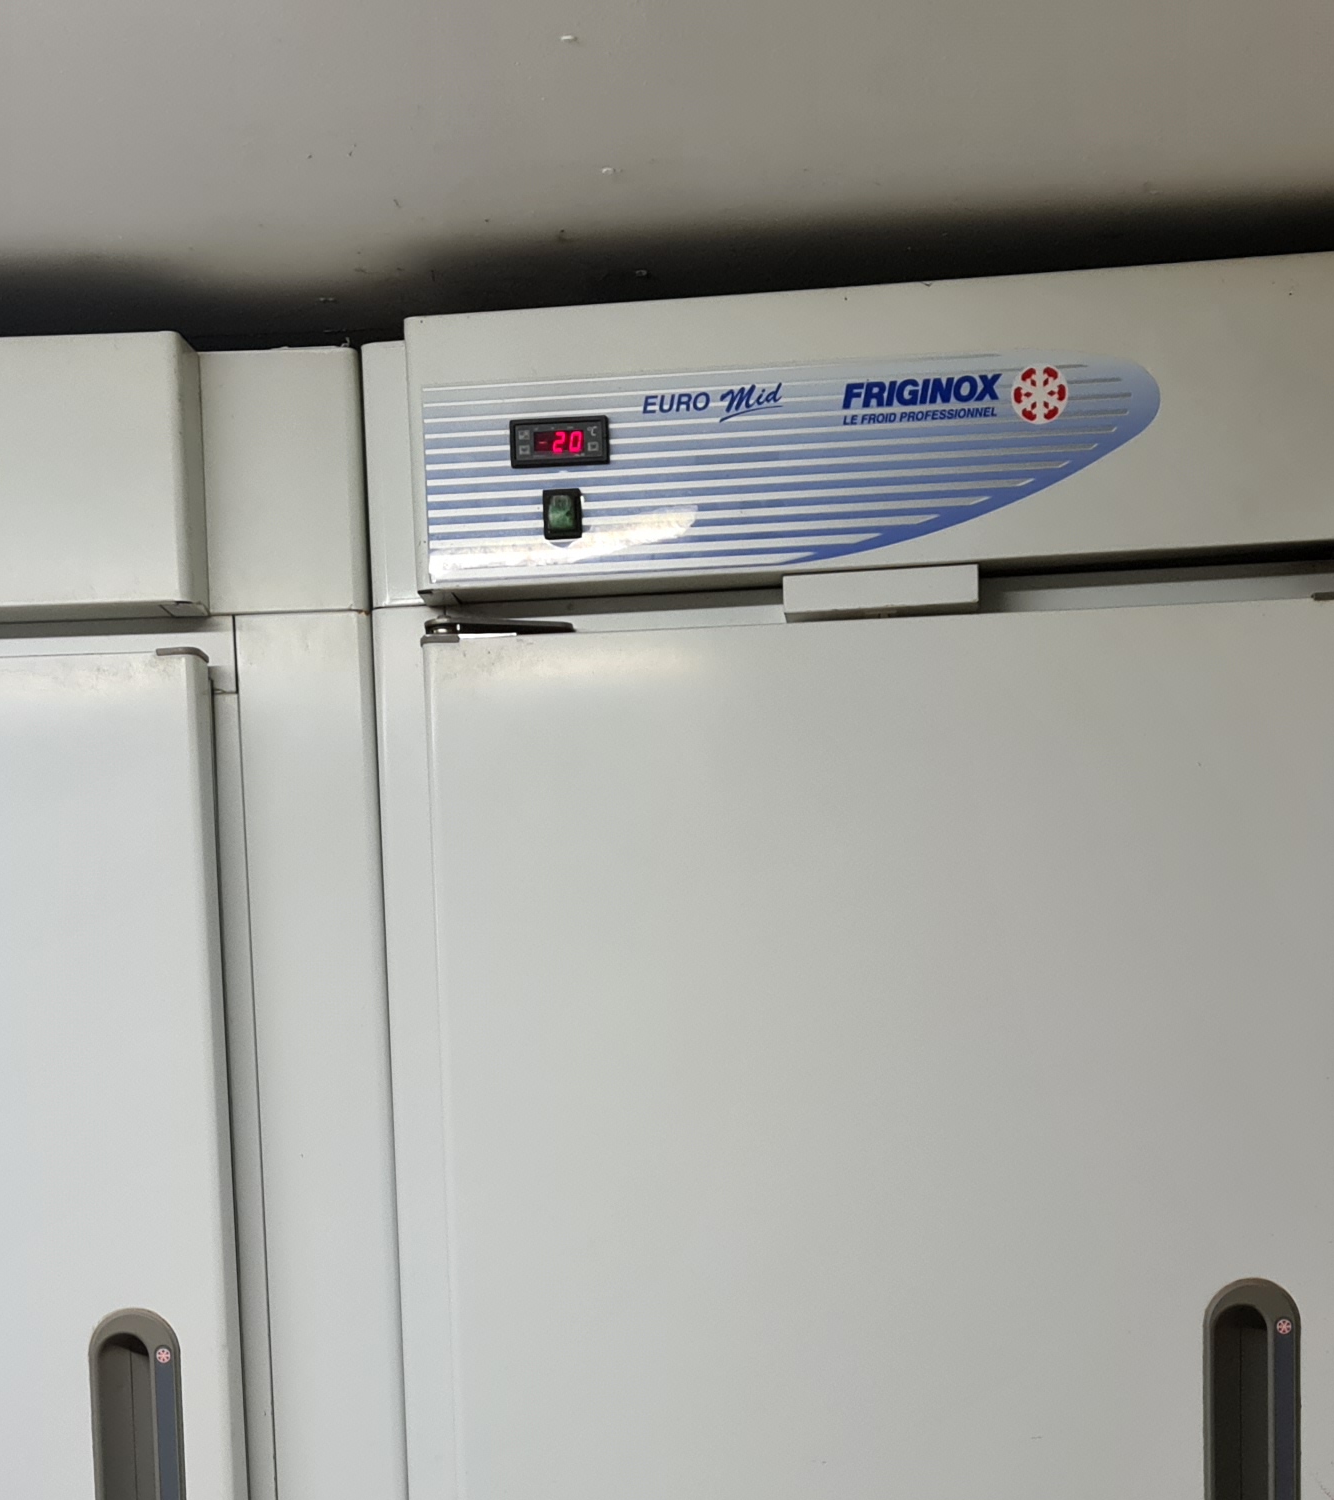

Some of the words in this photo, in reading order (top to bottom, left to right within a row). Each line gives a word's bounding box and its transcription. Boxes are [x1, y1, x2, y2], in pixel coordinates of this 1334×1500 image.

[642, 391, 711, 415] EURO
[719, 382, 782, 416] Mid
[842, 374, 1002, 409] FRIGINOX
[843, 415, 859, 425] LE
[861, 412, 897, 424] FROID
[899, 407, 997, 422] PROFESSIONNEL
